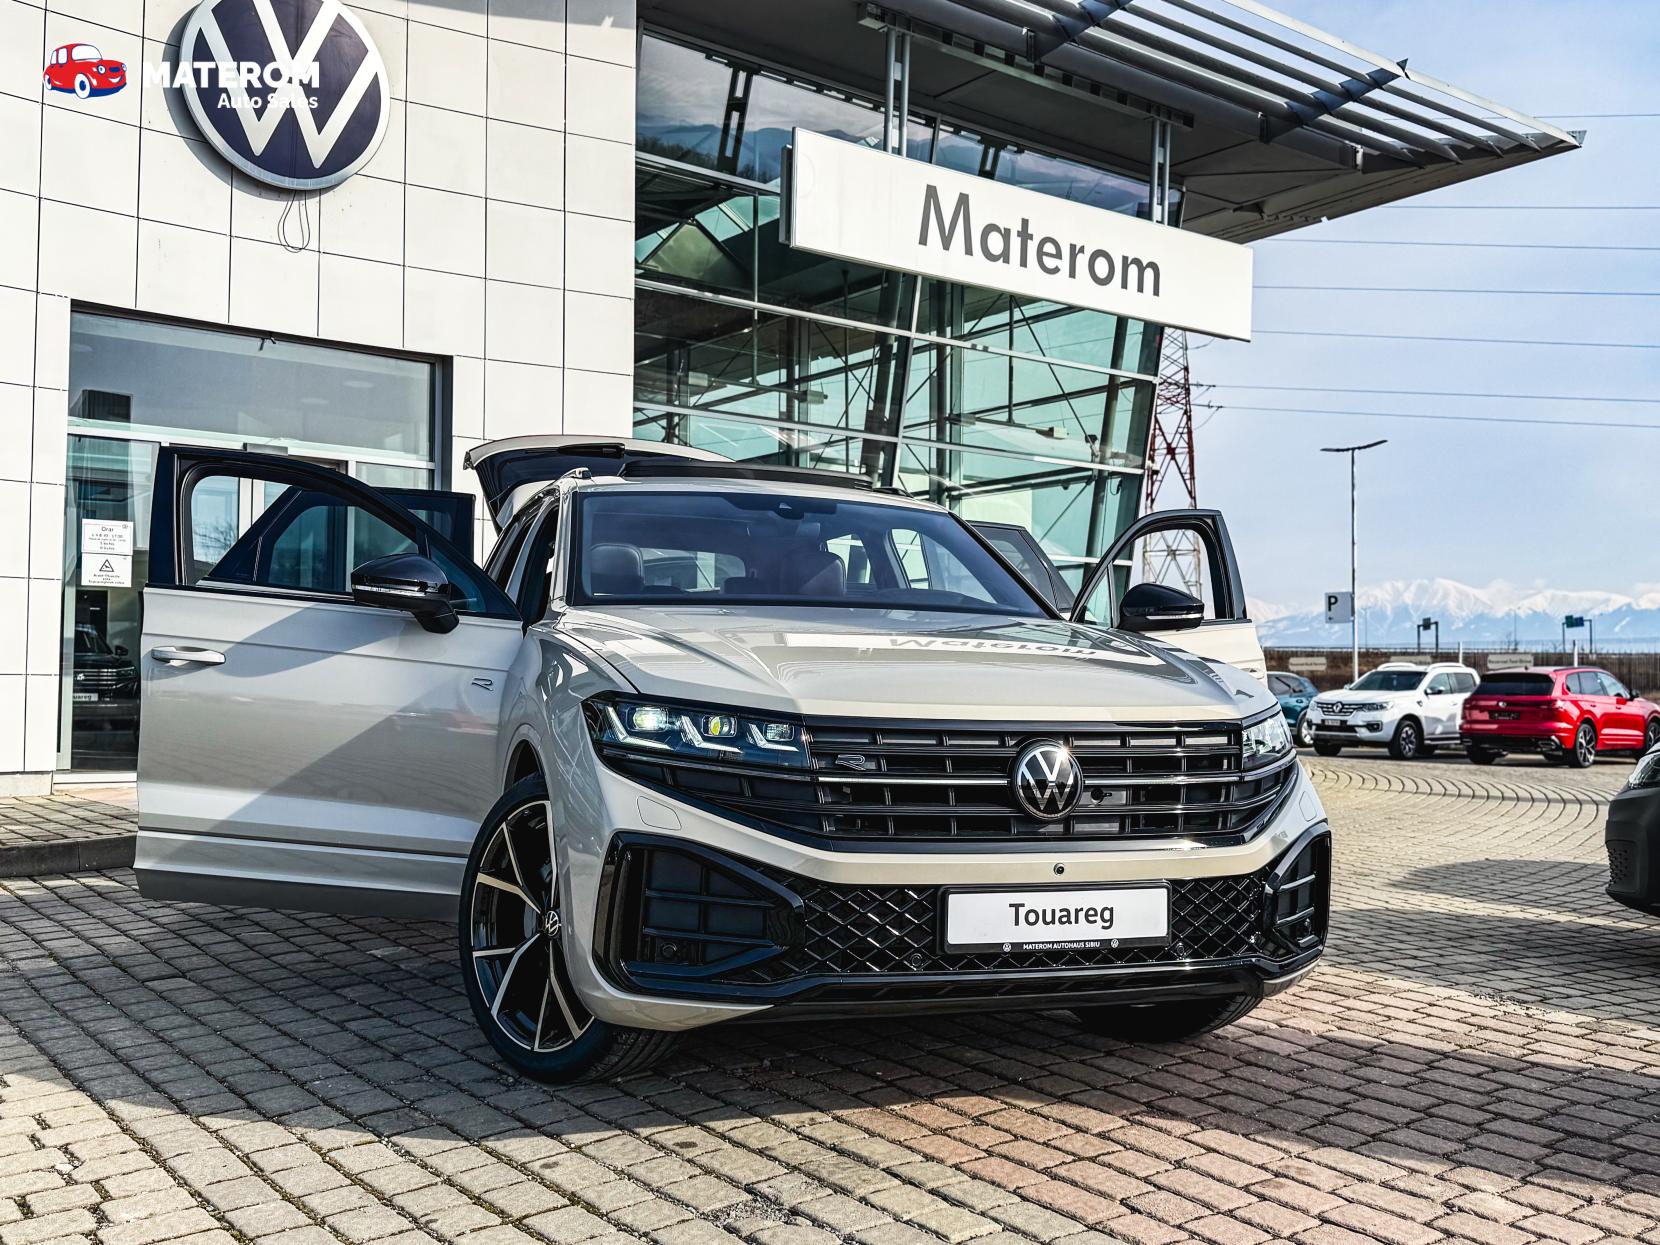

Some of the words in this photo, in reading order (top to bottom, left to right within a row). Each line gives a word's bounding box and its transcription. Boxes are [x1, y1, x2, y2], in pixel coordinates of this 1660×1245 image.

[918, 184, 1161, 298] Materom
[1328, 595, 1338, 611] P
[1008, 903, 1114, 930] Touareg
[1053, 941, 1085, 949] AUTOHAUS
